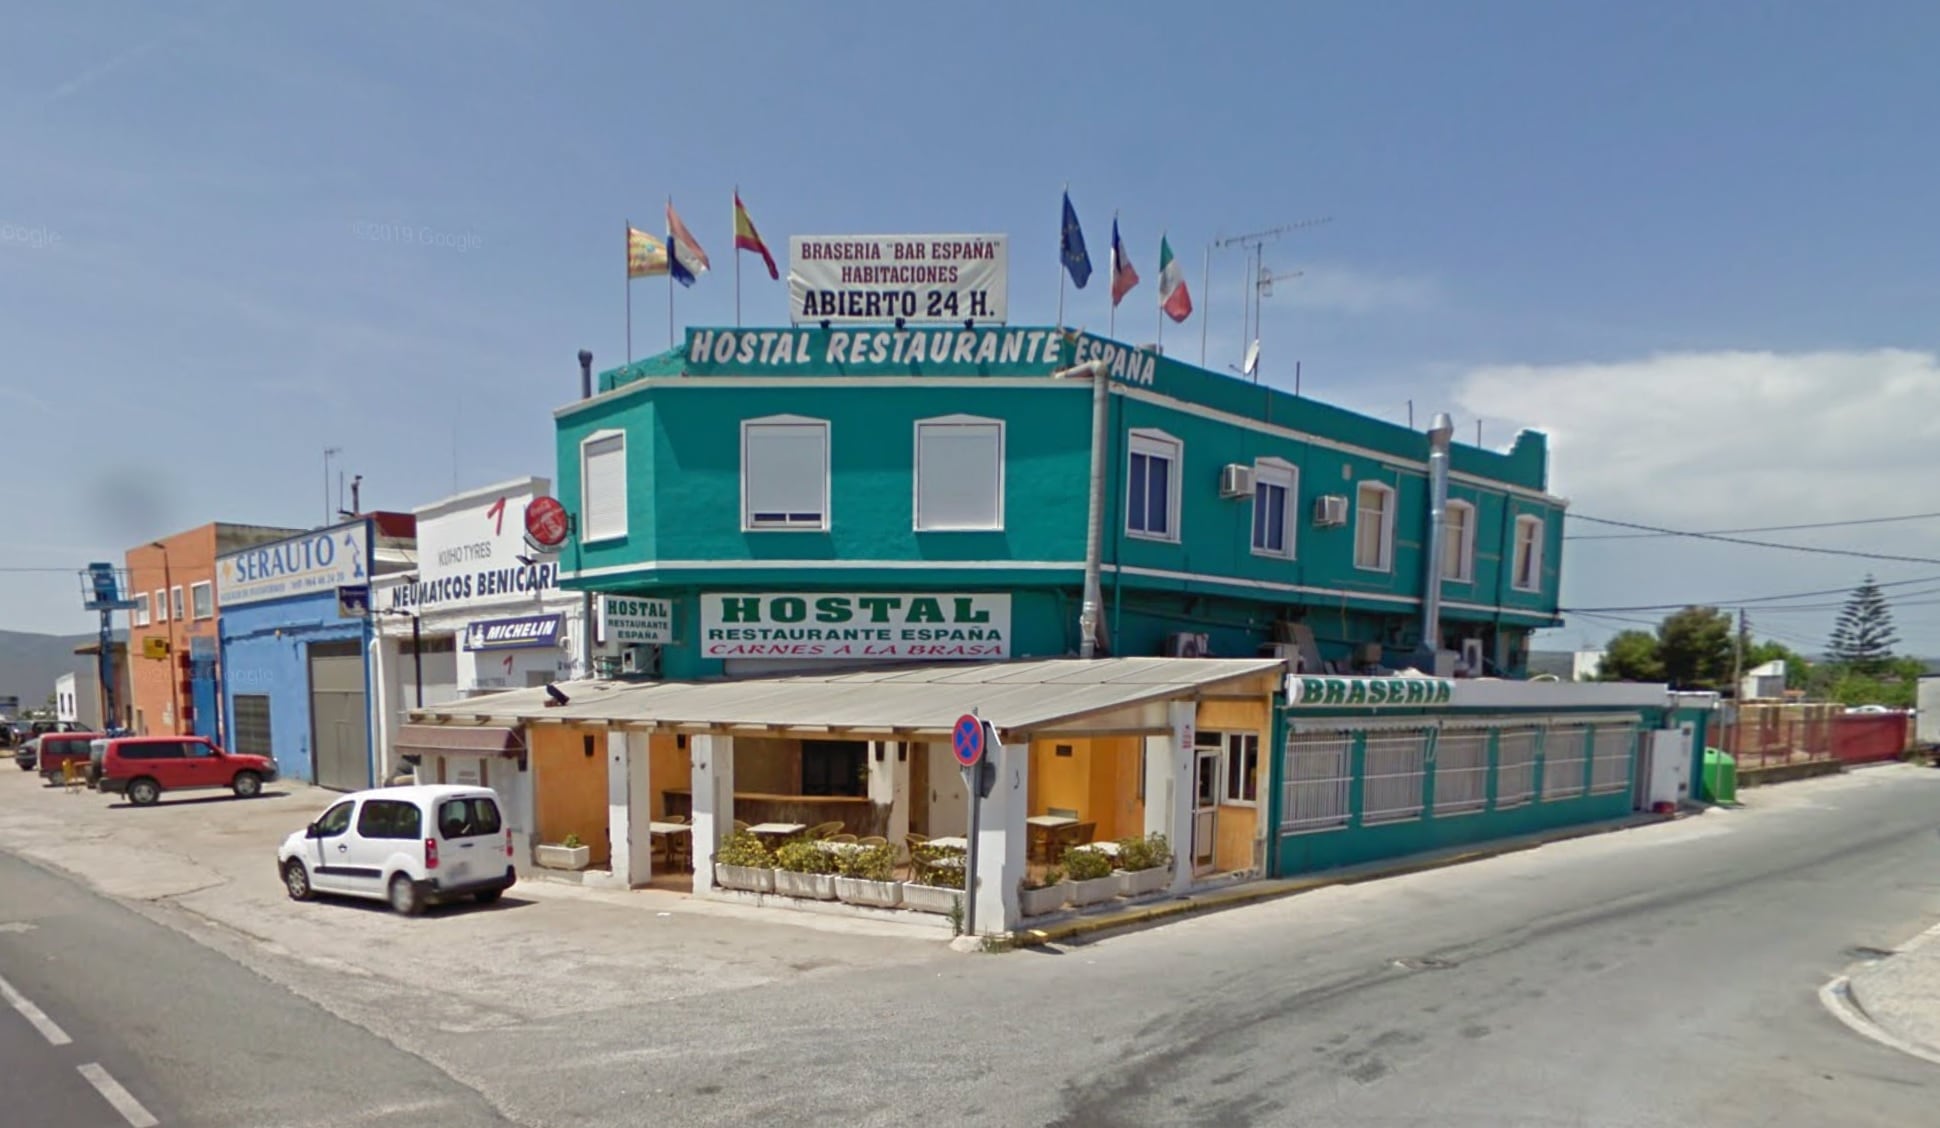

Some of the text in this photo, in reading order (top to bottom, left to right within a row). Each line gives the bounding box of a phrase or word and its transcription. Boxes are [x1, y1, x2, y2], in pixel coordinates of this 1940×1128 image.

[801, 242, 881, 260] BRASERIA
[842, 266, 958, 283] HABITACIONES
[802, 289, 995, 316] ABIERTO 24 H.
[690, 330, 1156, 385] HOSTAL RESTAURANTE ESPAÑA
[236, 534, 335, 583] SERAUTO
[463, 541, 492, 561] TYRES
[608, 600, 667, 617] HOSTAL
[721, 597, 990, 623] HOSTAL
[487, 620, 556, 640] MICHELIN
[608, 618, 668, 630] RESTAURANTE
[708, 626, 1002, 641] RESTAURANTE ESPAÑA
[709, 644, 1002, 655] CARNES A LA BRASA
[1301, 678, 1452, 704] BRASERIA
